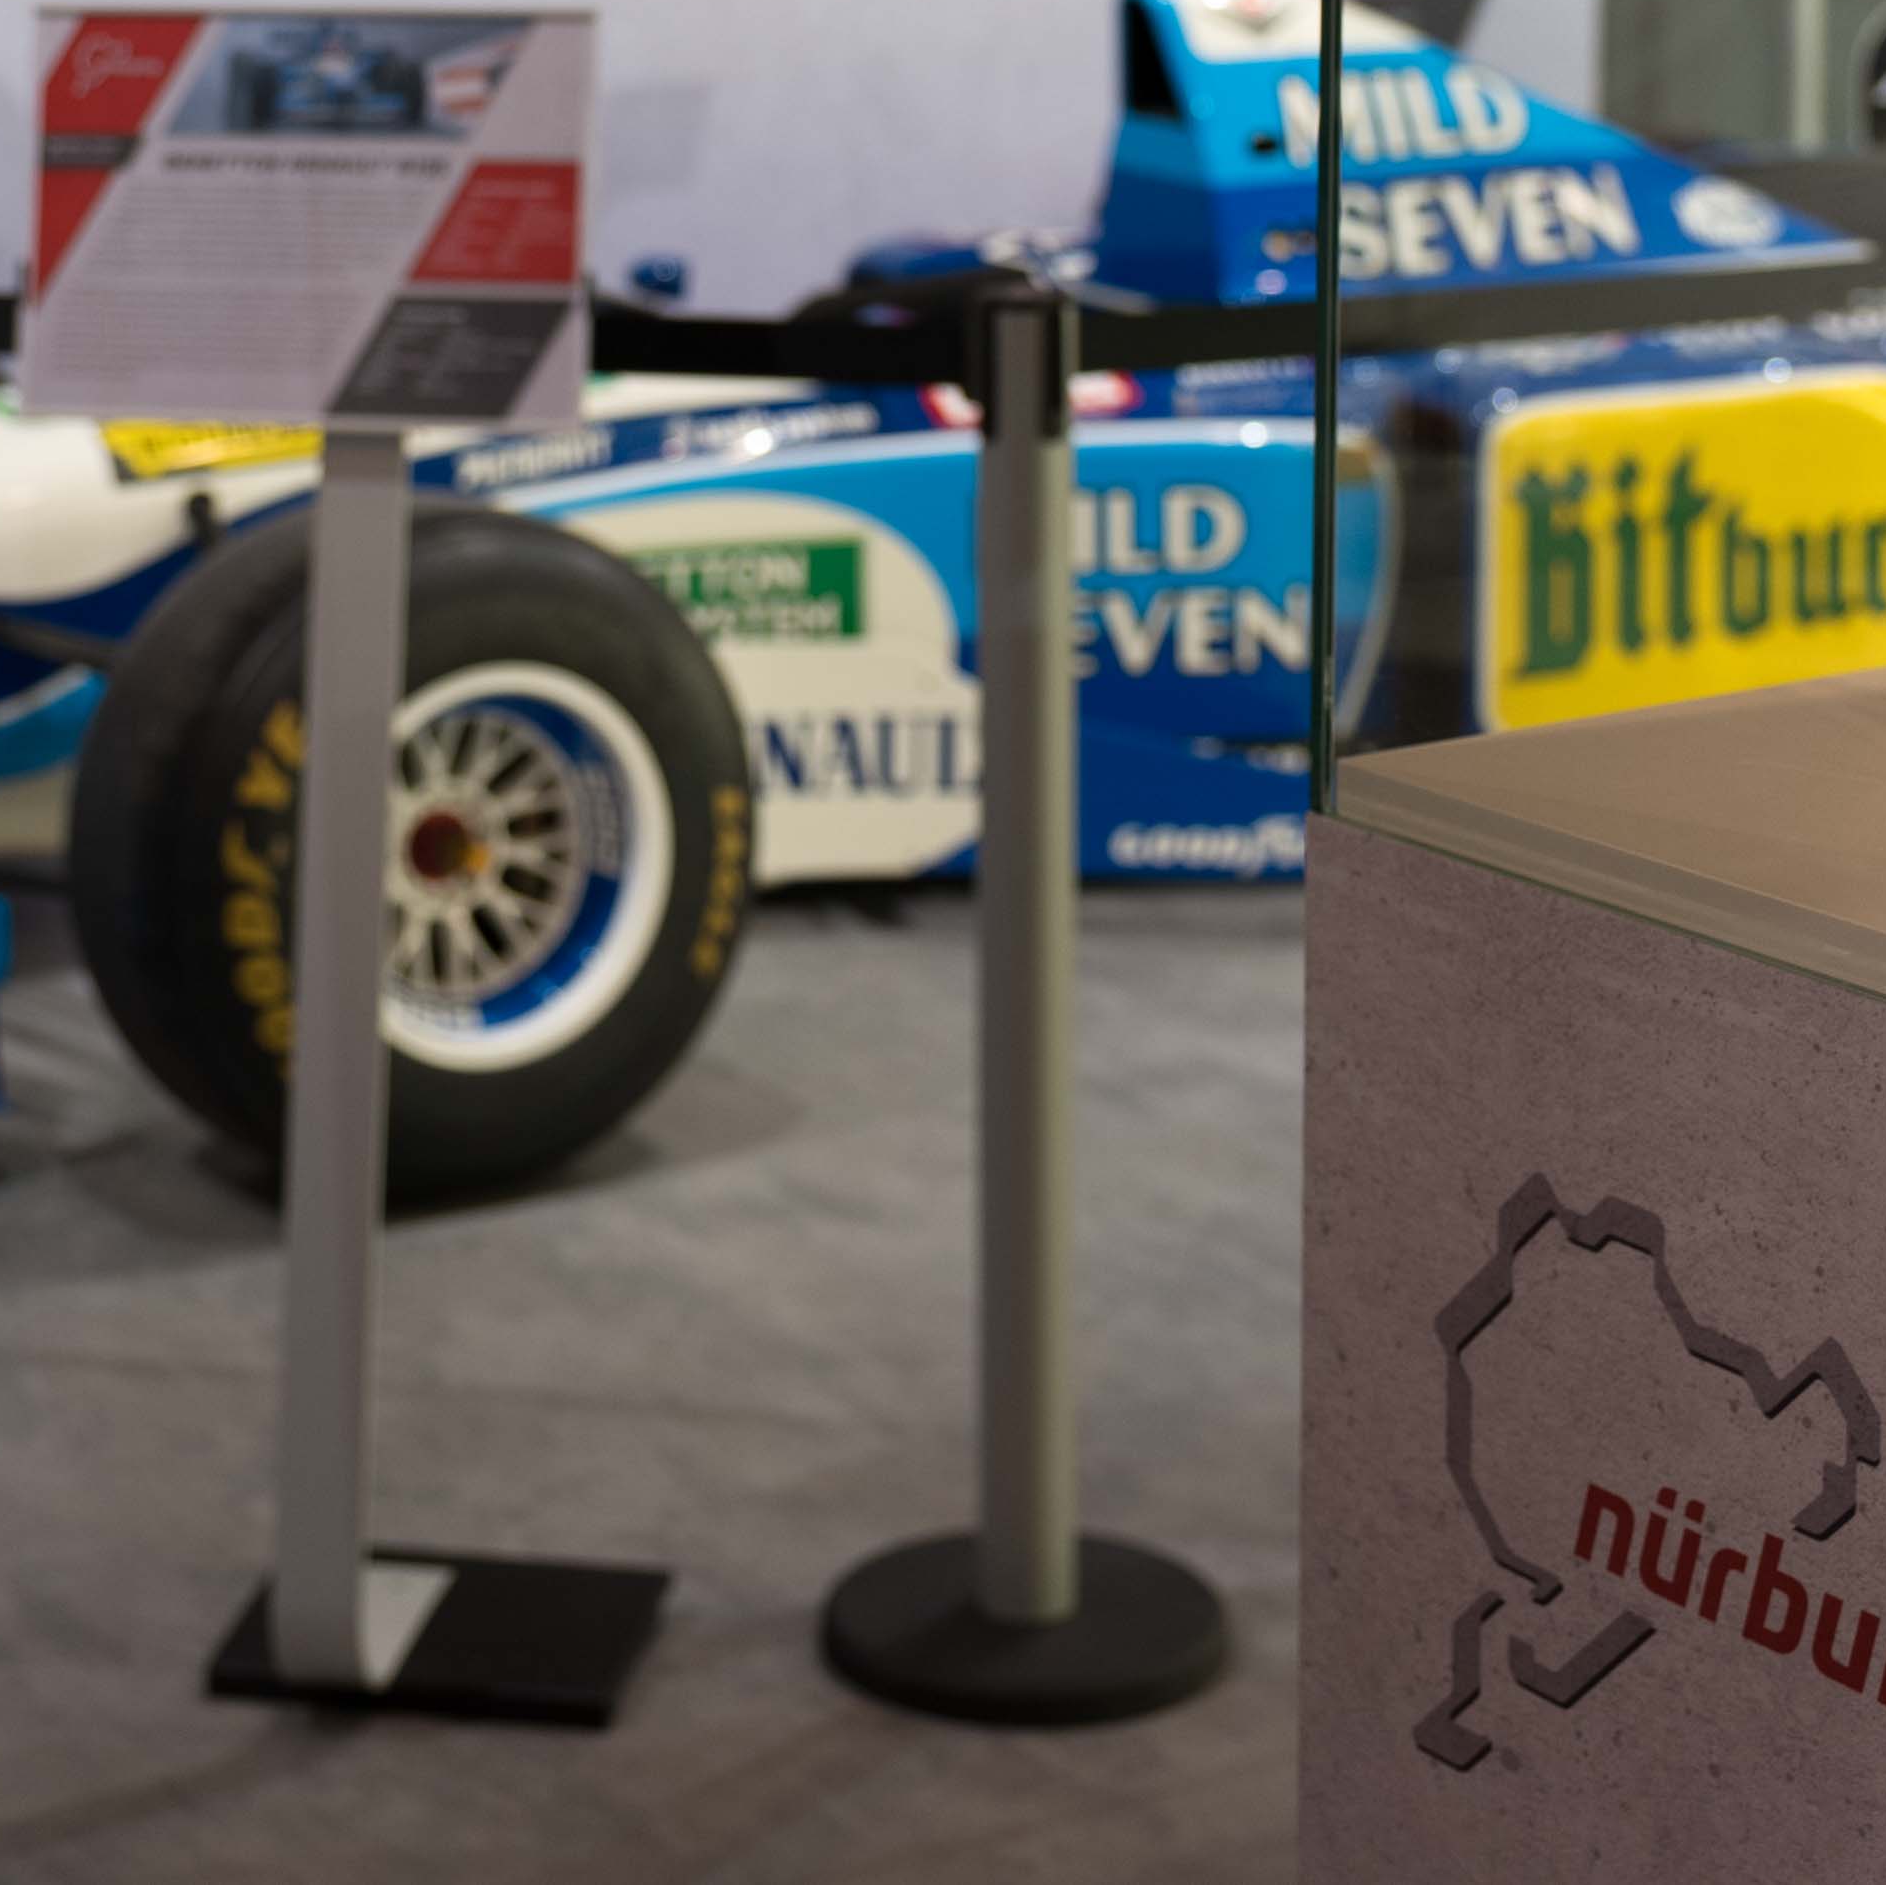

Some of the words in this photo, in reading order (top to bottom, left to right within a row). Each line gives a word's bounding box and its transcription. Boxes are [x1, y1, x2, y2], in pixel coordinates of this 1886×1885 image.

[1277, 63, 1529, 169] MILD
[1338, 164, 1642, 281] SEVEN
[1068, 484, 1247, 576] ILD
[747, 712, 981, 800] NAUL
